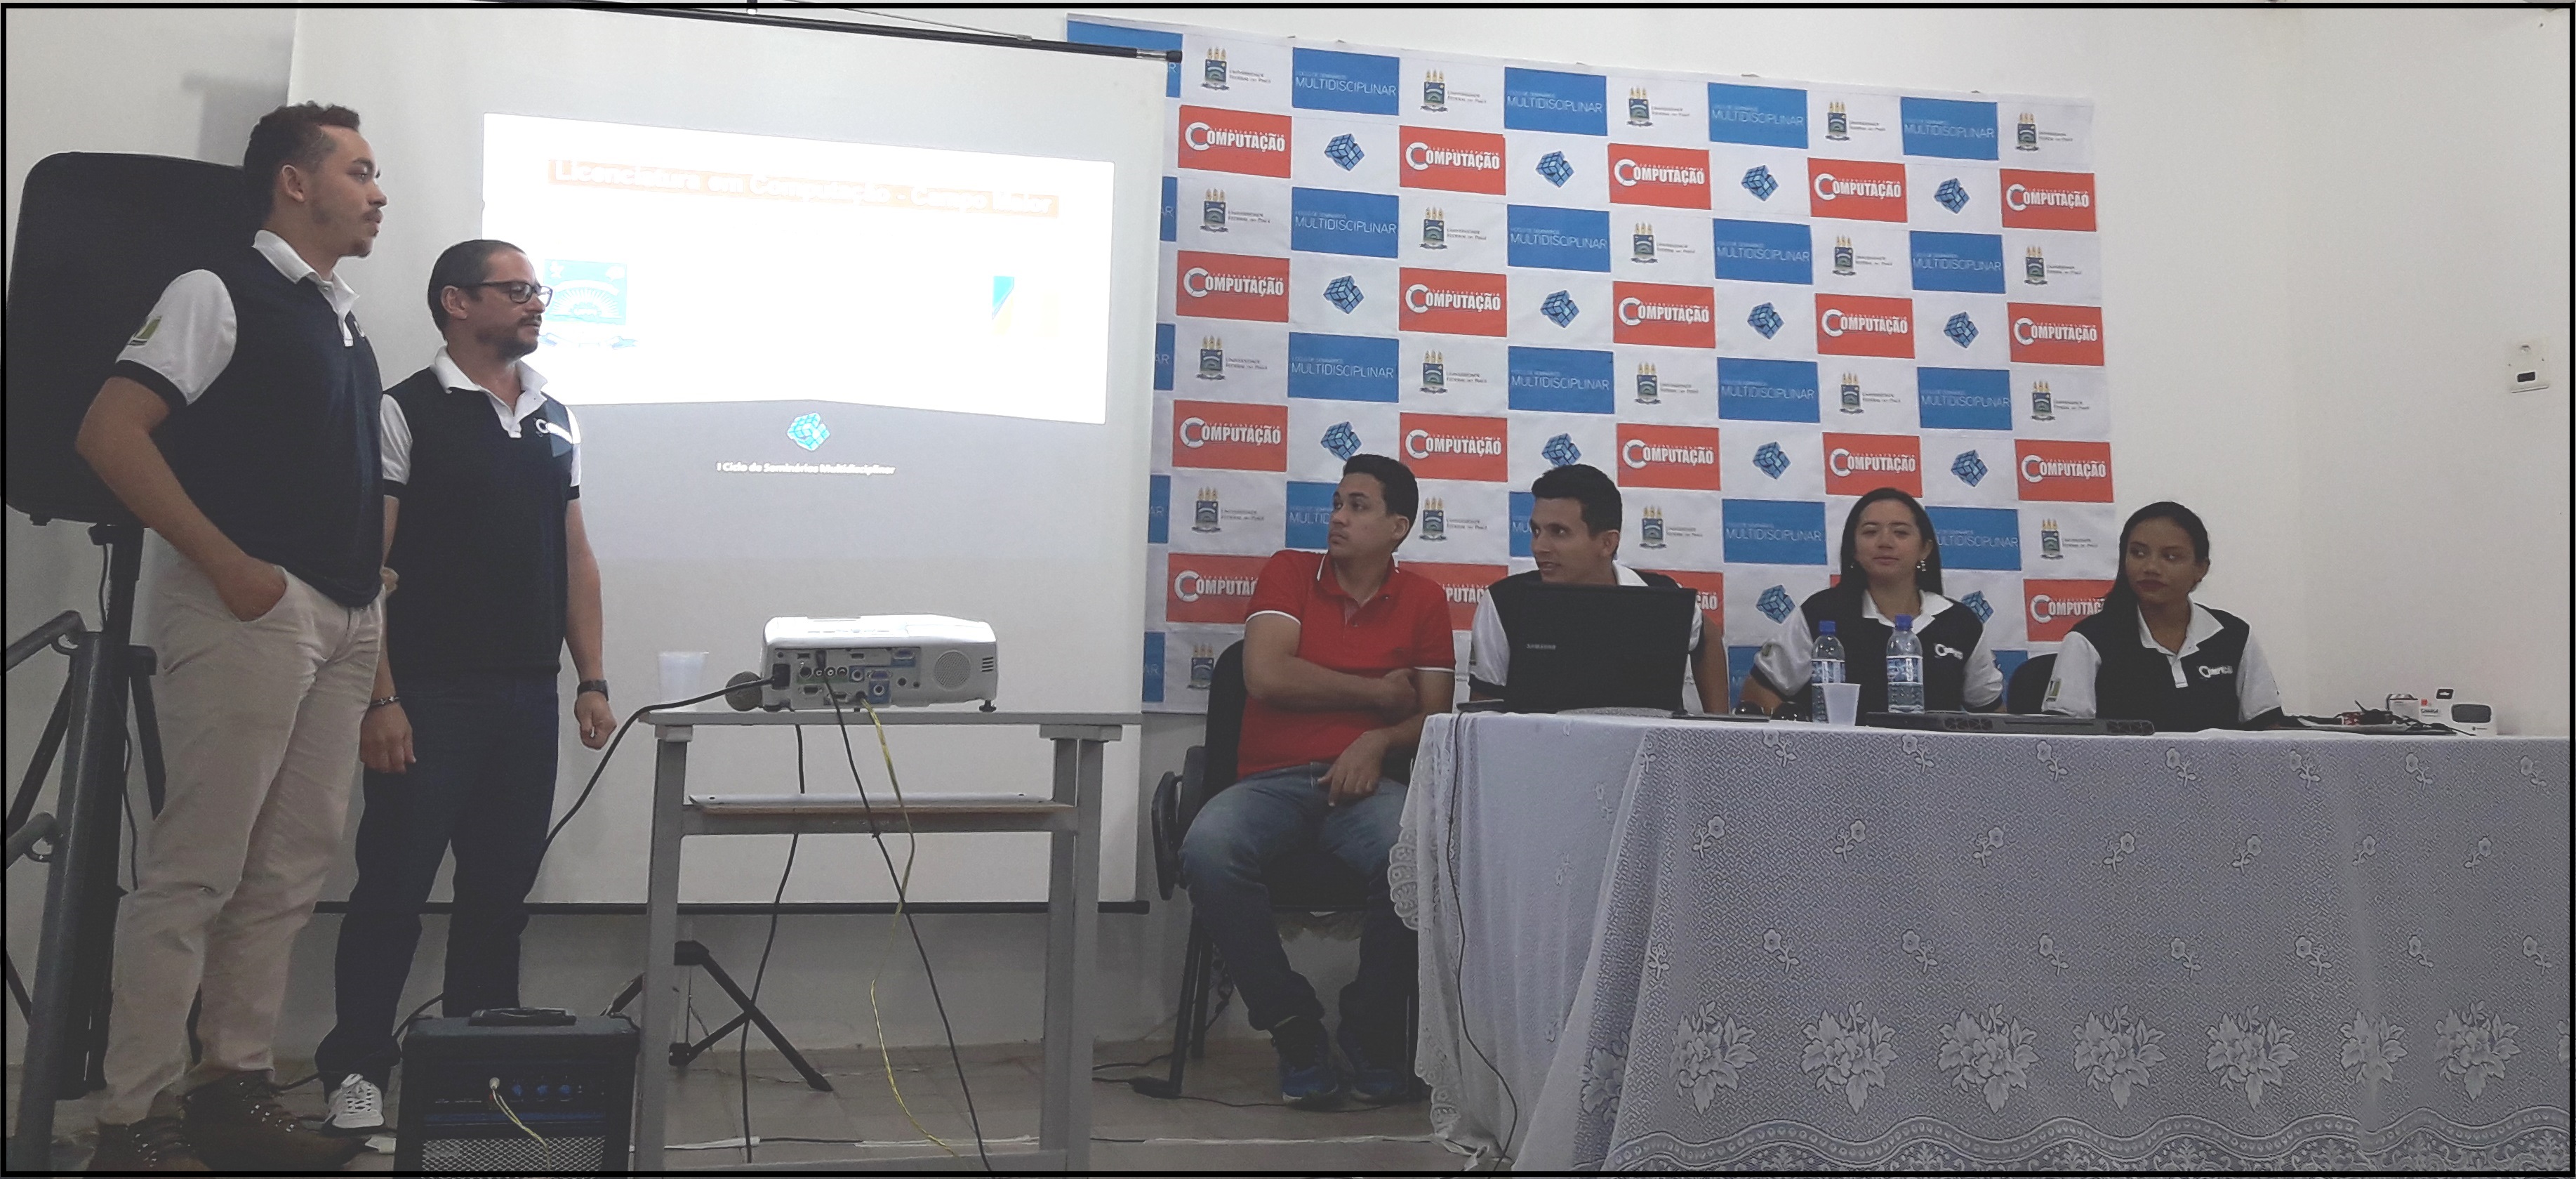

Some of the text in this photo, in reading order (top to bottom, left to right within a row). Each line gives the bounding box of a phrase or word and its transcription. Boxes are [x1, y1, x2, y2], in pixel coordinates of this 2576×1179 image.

[1295, 77, 1396, 96] MULTIDISCIPLINAR
[1507, 94, 1602, 114] MULTIDISCIPLINAR
[1185, 121, 1286, 152] COMPUTAÇÃO
[1405, 142, 1501, 171] COMPUTAÇÃO
[555, 160, 701, 192] Licenciatura
[708, 176, 743, 193] em
[749, 174, 891, 204] Computação
[911, 187, 987, 211] Campo
[992, 191, 1052, 214] Maior
[1614, 158, 1706, 187] COMPUTAÇÃO
[1814, 173, 1901, 200] COMPUTAÇÃO
[2006, 183, 2090, 211] COMPUTAÇÃO
[1295, 215, 1397, 235] MULTIDISCIPLINAR
[1510, 233, 1606, 250] MULTIDISCIPLINAR
[1183, 267, 1284, 298] COMPUTAÇÃO
[1405, 284, 1501, 313] COMPUTAÇÃO
[1619, 296, 1710, 326] COMPUTAÇÃO
[1821, 308, 1908, 337] COMPUTAÇÃO
[2014, 317, 2097, 345] COMPUTAÇÃO
[1291, 362, 1395, 378] MULTIDISCIPLINAR
[1511, 375, 1609, 391] MULTIDISCIPLINAR
[1180, 416, 1282, 447] COMPUTAÇÃO
[1405, 429, 1502, 459] COMPUTAÇÃO
[722, 462, 748, 472] Ciclo
[748, 462, 762, 473] de
[1622, 439, 1714, 468] COMPUTAÇÃO
[1829, 447, 1916, 477] COMPUTAÇÃO
[2021, 454, 2106, 482] COMPUTAÇÃO
